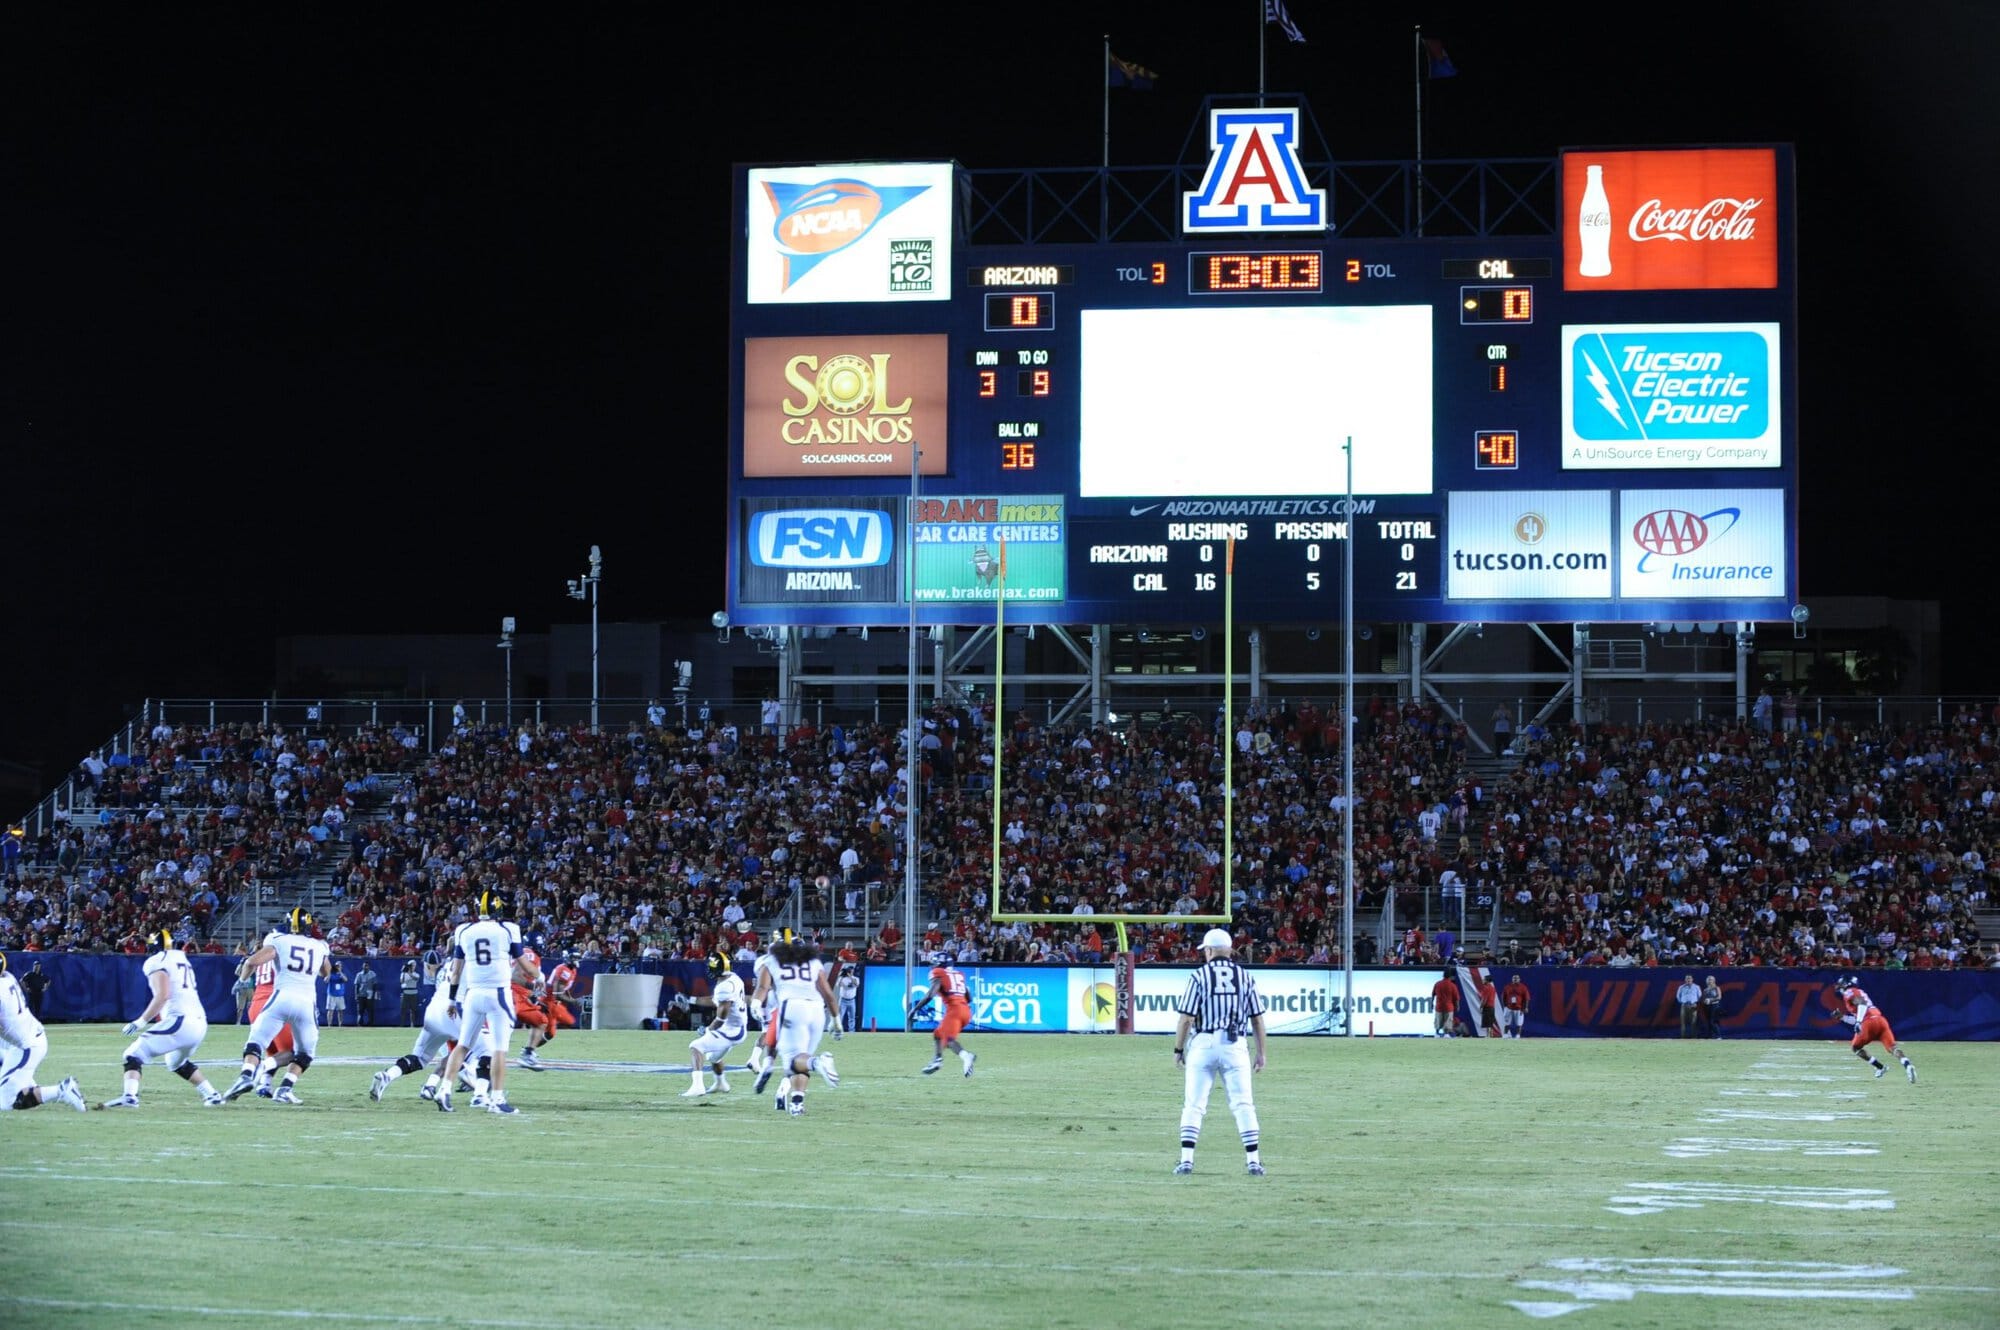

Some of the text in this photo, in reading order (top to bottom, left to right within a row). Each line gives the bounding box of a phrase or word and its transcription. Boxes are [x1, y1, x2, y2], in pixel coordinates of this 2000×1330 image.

[1183, 107, 1327, 234] A
[791, 209, 862, 238] NCAA
[1628, 198, 1764, 242] Coca-Cola
[891, 252, 931, 265] PAC
[891, 265, 931, 282] 10
[984, 266, 1058, 286] ARIZONA
[1116, 267, 1148, 282] TOL
[1152, 262, 1165, 284] 3
[1209, 255, 1319, 290] 13:03
[1346, 260, 1360, 281] 2
[1364, 264, 1396, 279] TOL
[1478, 260, 1514, 279] CAL
[1011, 297, 1038, 326] 0
[1504, 290, 1530, 319] 0
[976, 351, 999, 366] DWN
[1018, 351, 1048, 365] TO GO
[1487, 345, 1508, 360] QTR
[1622, 345, 1722, 372] Tucson
[782, 354, 913, 416] SOL
[980, 371, 995, 397] 3
[1034, 371, 1049, 396] 9
[1631, 372, 1750, 398] Electric
[1643, 398, 1750, 424] Power
[781, 416, 913, 445] CASINOS
[998, 423, 1038, 437] BALL ON
[802, 453, 893, 464] SOLCASINOS.COM
[1002, 443, 1034, 469] 36
[1479, 435, 1515, 465] 40
[1573, 446, 1768, 461] A UniSource Energy Company
[909, 499, 1063, 523] BRAKE max
[1161, 500, 1376, 516] ARIZONAATHLETICS.COM
[771, 517, 870, 560] FSN
[947, 525, 988, 542] CARE
[992, 524, 1059, 542] CENTERS
[1168, 522, 1248, 541] RUSHING
[1378, 521, 1436, 540] TOTAL
[1641, 510, 1703, 555] AAA
[1090, 543, 1414, 563] ARIZONA 0 0 0
[1453, 549, 1607, 571] tucson.com
[785, 572, 852, 590] ARIZONA
[1133, 572, 1417, 591] CAL 16 5 21
[1672, 562, 1773, 580] Insurance
[261, 886, 275, 895] 26
[1477, 896, 1493, 906] 29
[287, 945, 314, 976] 51
[474, 937, 492, 966] 6
[945, 973, 966, 994] 15
[970, 976, 1040, 996] Tucson
[1117, 956, 1130, 1020] ARIZONA
[1213, 966, 1236, 993] R
